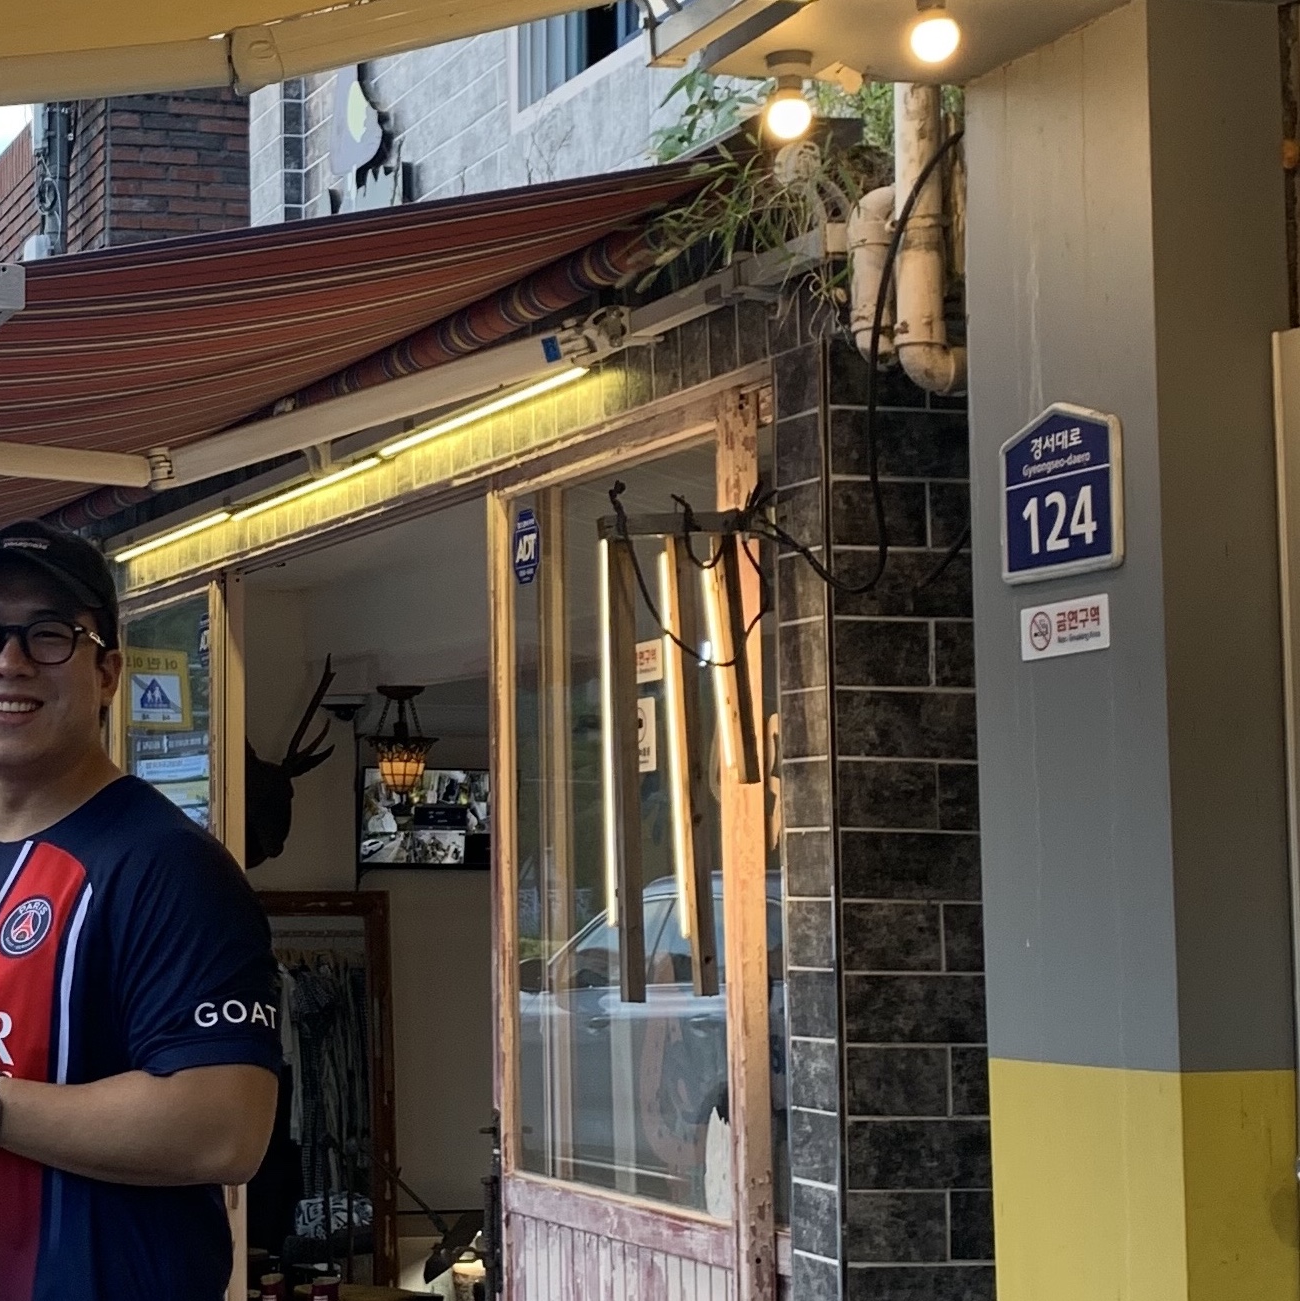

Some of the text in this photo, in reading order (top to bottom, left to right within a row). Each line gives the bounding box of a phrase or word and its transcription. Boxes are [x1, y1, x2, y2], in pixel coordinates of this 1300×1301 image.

[1030, 427, 1082, 460] 경서대로
[1022, 452, 1091, 478] Gyeongseo-daero
[1022, 485, 1098, 555] 124
[515, 533, 537, 563] ADT
[1056, 606, 1100, 632] 금연구역
[19, 901, 48, 916] PARIS
[194, 1000, 277, 1029] GOAT
